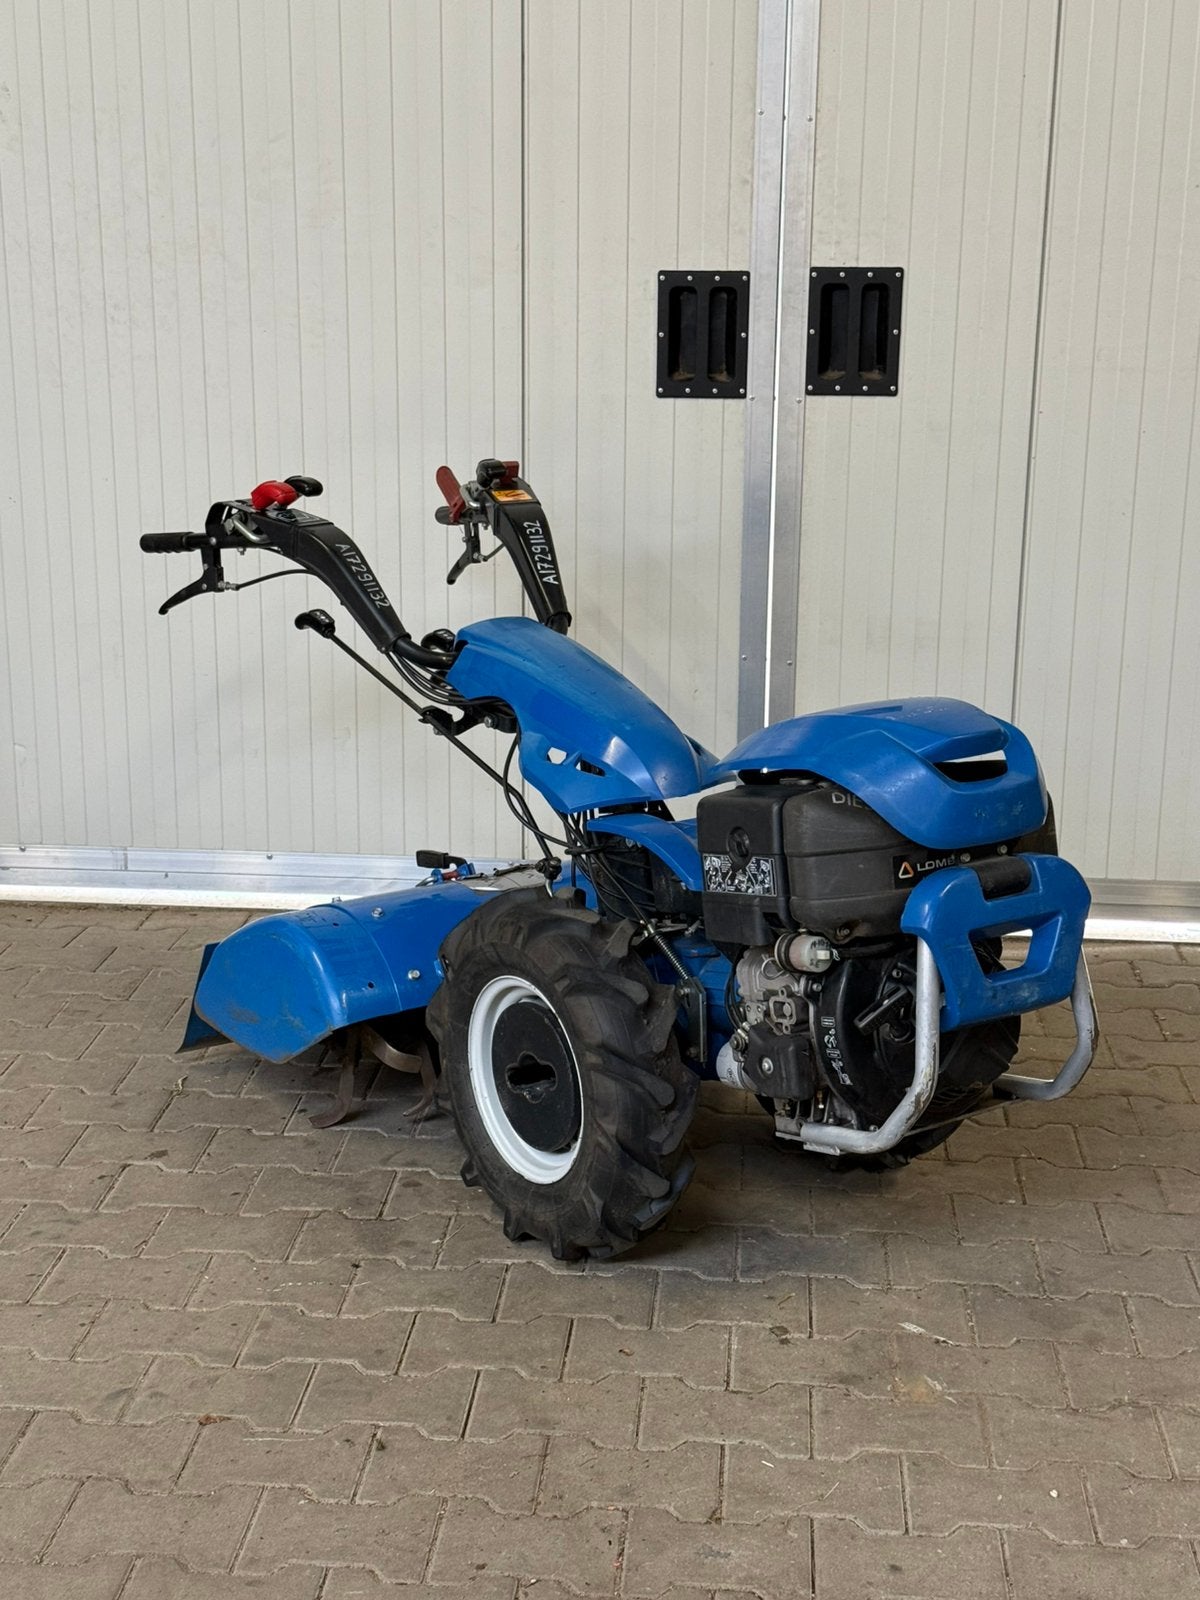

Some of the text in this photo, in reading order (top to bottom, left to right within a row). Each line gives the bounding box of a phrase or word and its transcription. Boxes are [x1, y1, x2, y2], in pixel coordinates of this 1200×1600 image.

[523, 520, 559, 585] A17291132
[335, 543, 390, 609] A17291132
[831, 791, 865, 809] DIE
[916, 856, 956, 872] LOMB
